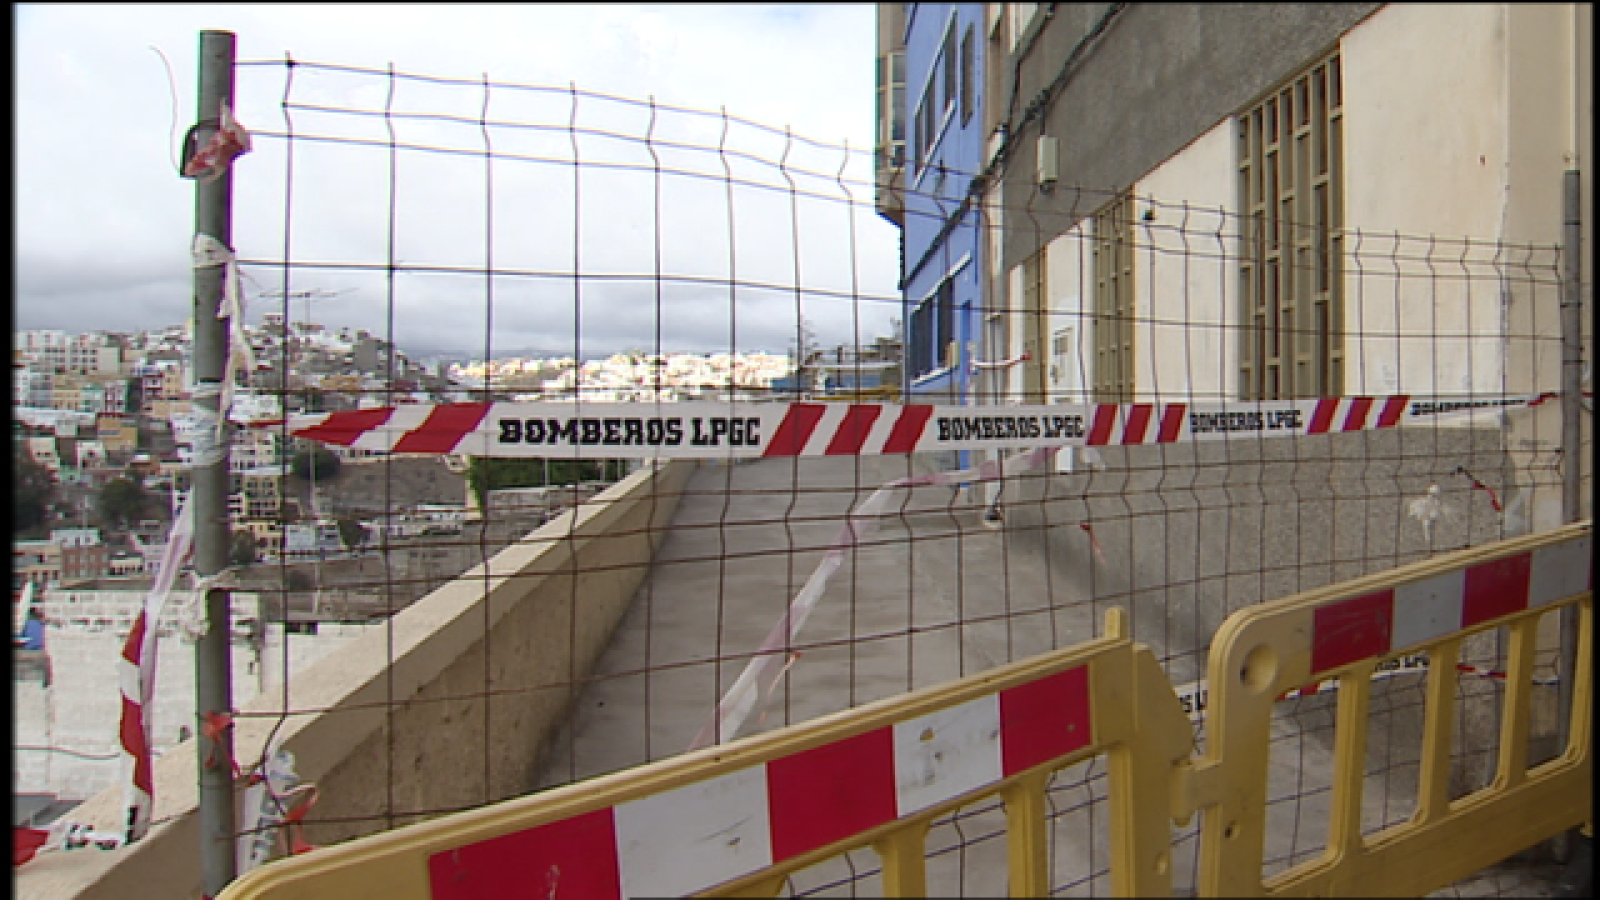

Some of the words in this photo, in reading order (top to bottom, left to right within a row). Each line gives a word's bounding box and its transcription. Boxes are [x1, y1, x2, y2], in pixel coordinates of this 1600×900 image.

[499, 418, 682, 446] BOMBEROS
[690, 417, 760, 446] LPGC
[937, 418, 1040, 441] BOMBEROS
[1042, 415, 1086, 439] LPGC
